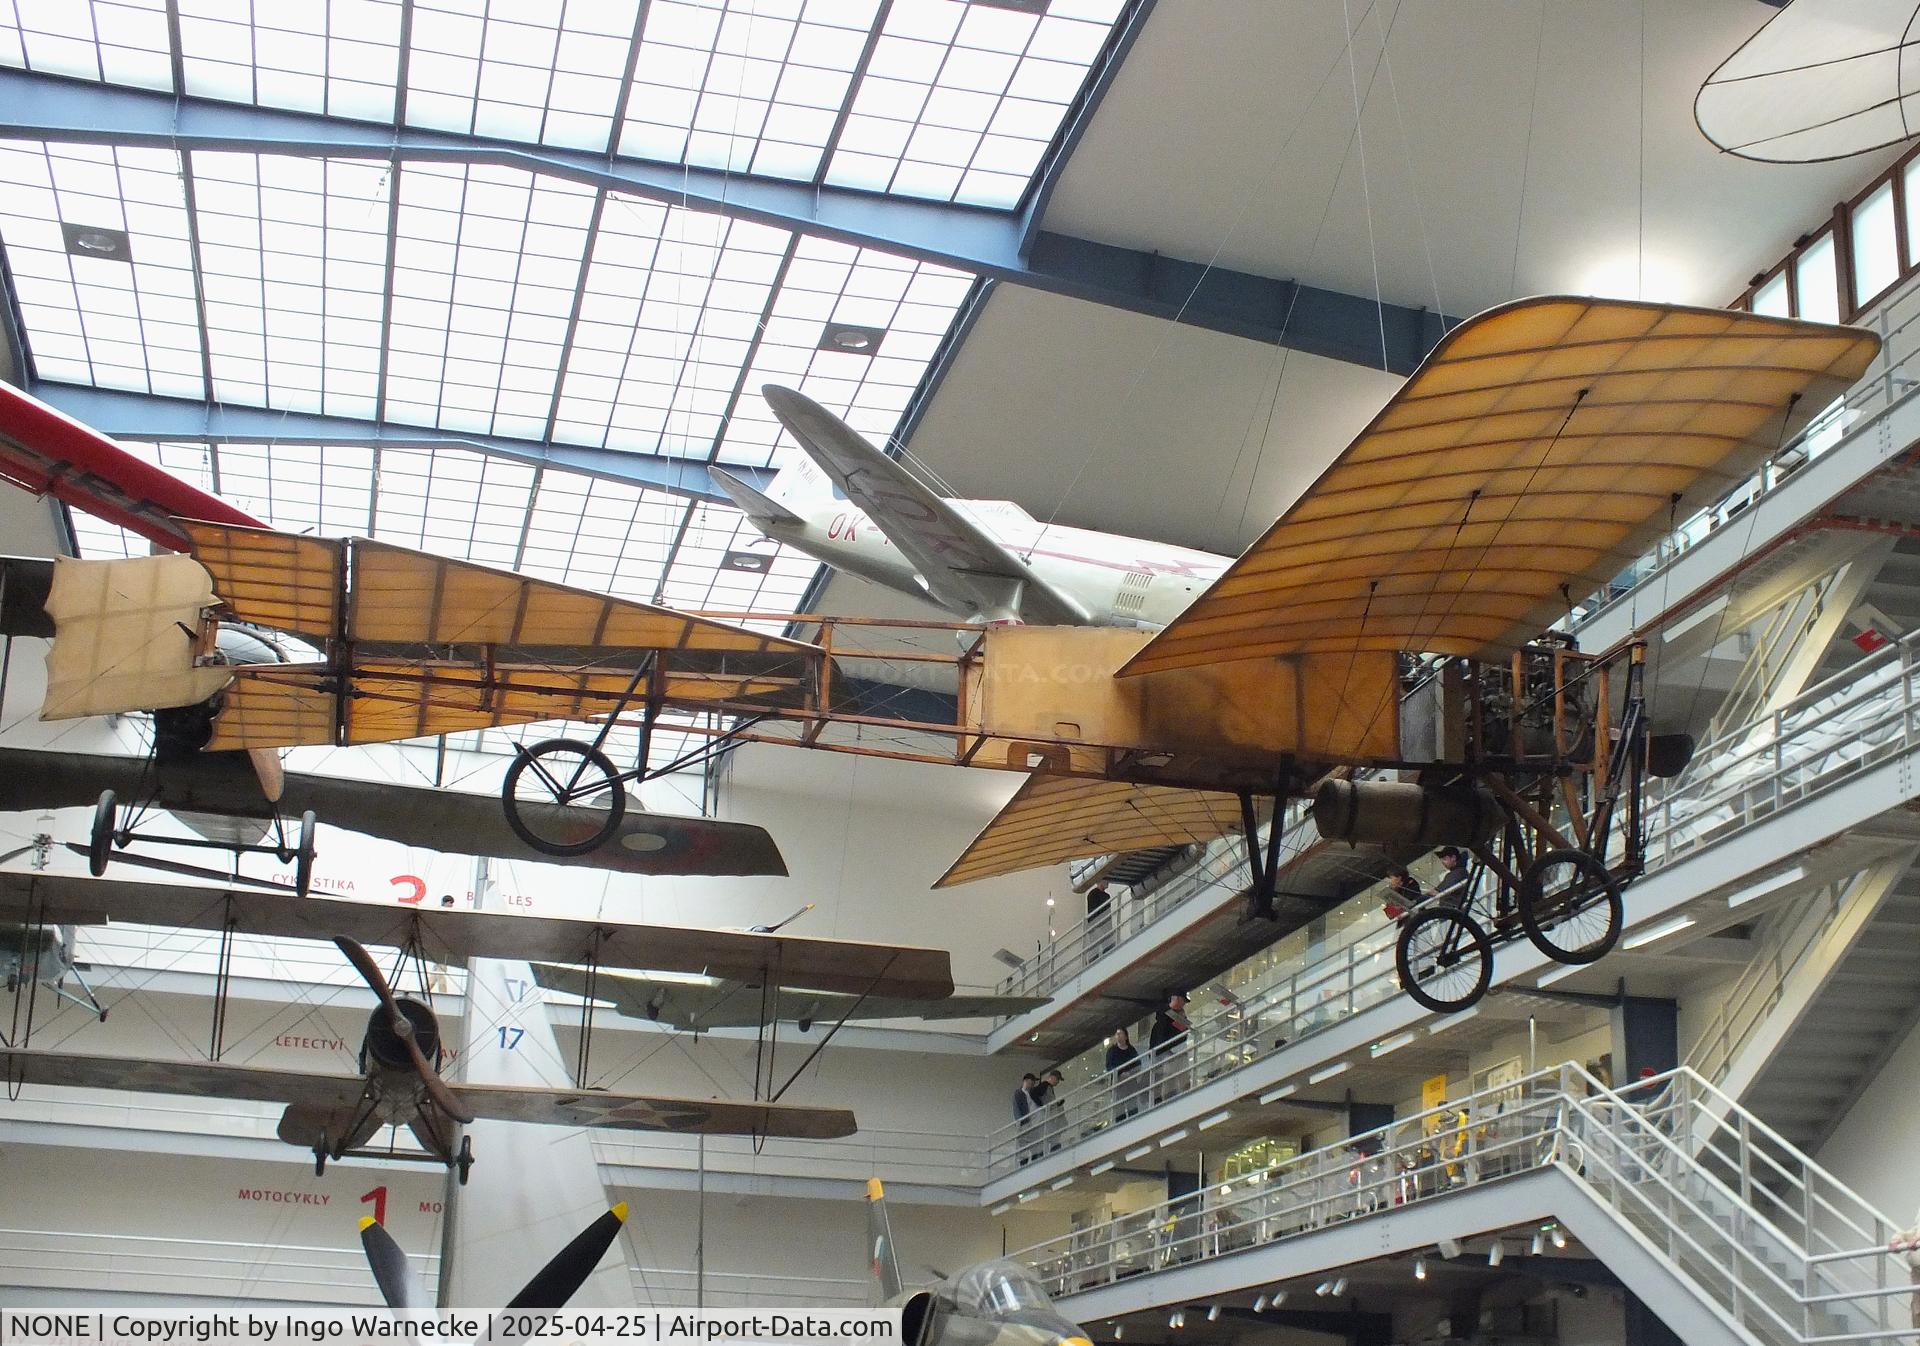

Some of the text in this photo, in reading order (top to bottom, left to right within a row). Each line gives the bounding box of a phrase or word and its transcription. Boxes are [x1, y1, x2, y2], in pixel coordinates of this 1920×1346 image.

[498, 1025, 524, 1050] 17
[238, 1188, 331, 1206] MOTOCYKLY
[360, 1186, 387, 1228] 1
